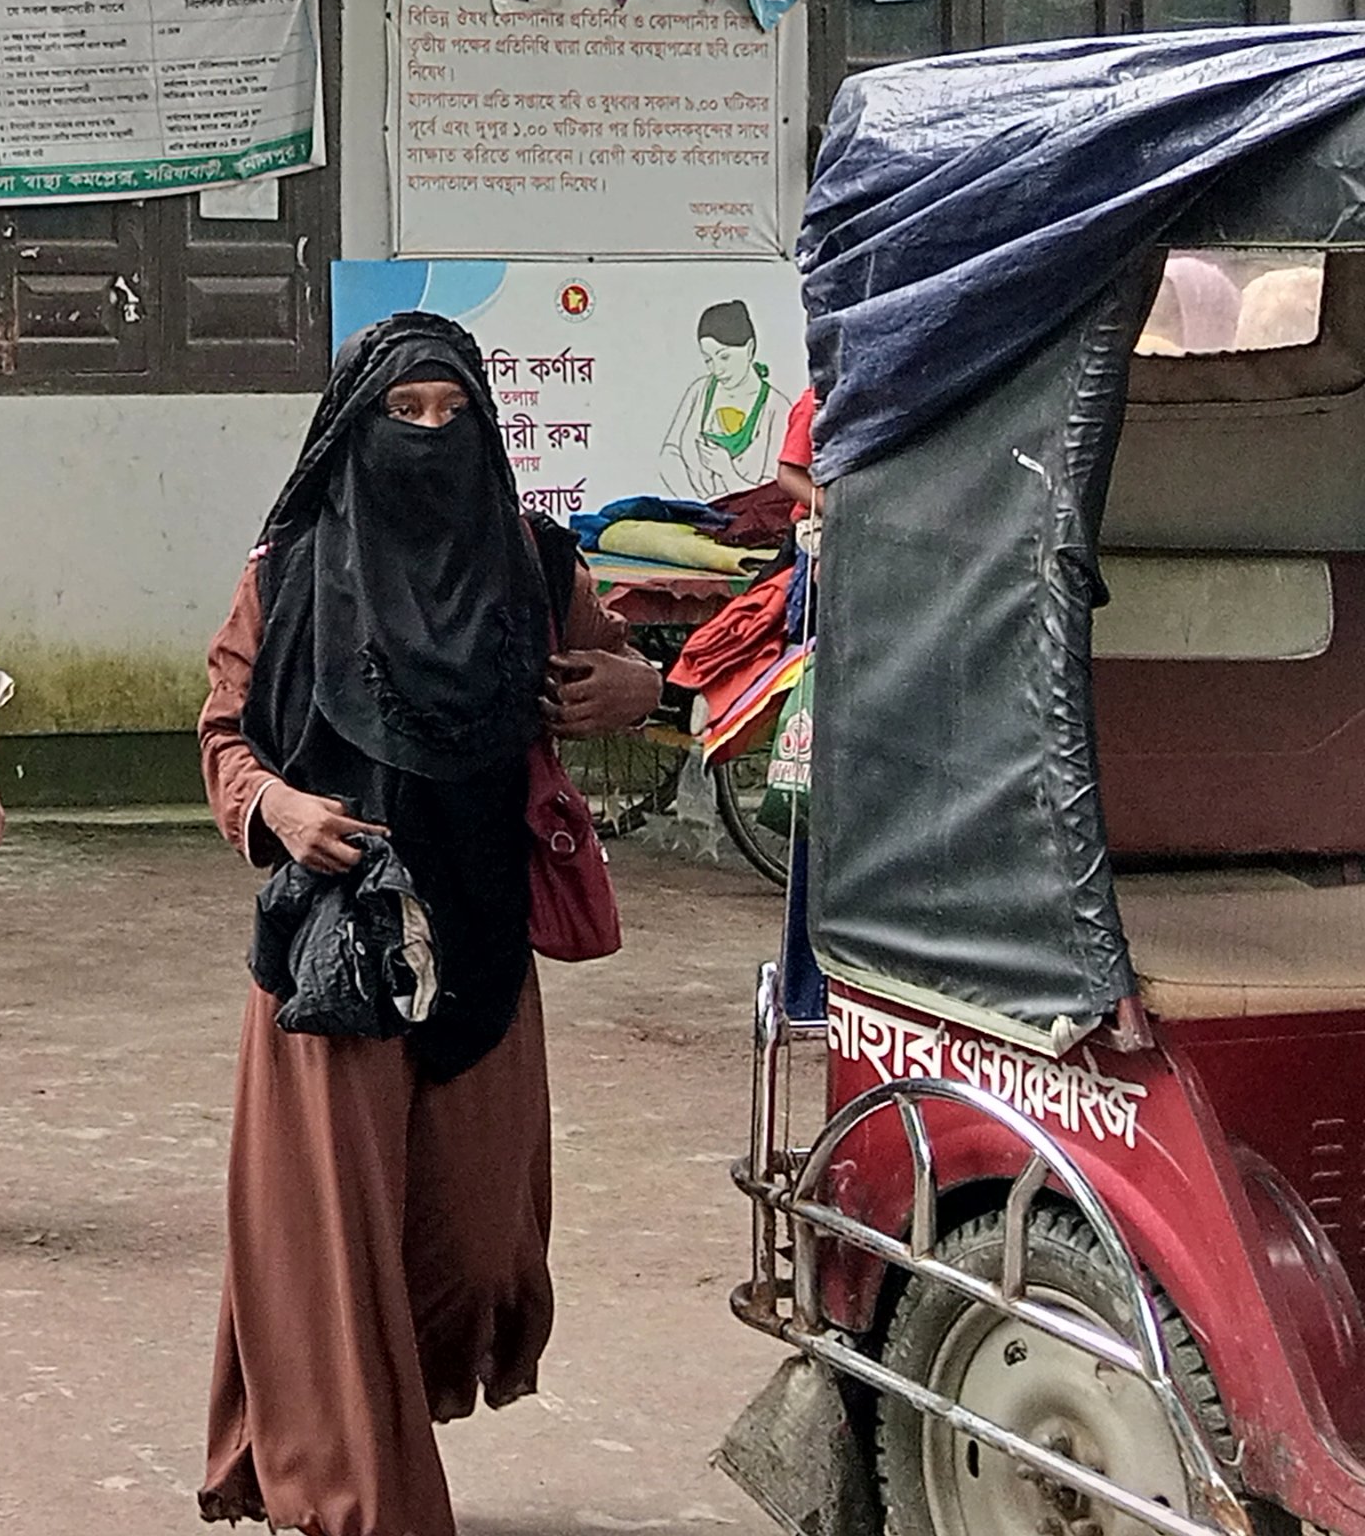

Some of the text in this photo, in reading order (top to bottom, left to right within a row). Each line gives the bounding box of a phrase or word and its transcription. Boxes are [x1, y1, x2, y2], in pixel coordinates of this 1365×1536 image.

[408, 5, 450, 29] বিভিন্ন
[634, 16, 645, 30] ও
[586, 96, 597, 110] ও
[442, 120, 471, 138] এবং
[513, 121, 548, 139] ১.০০
[609, 122, 628, 139] পর
[526, 347, 596, 384] কর্ণার
[545, 421, 592, 450] রুম
[509, 455, 542, 473] লায়
